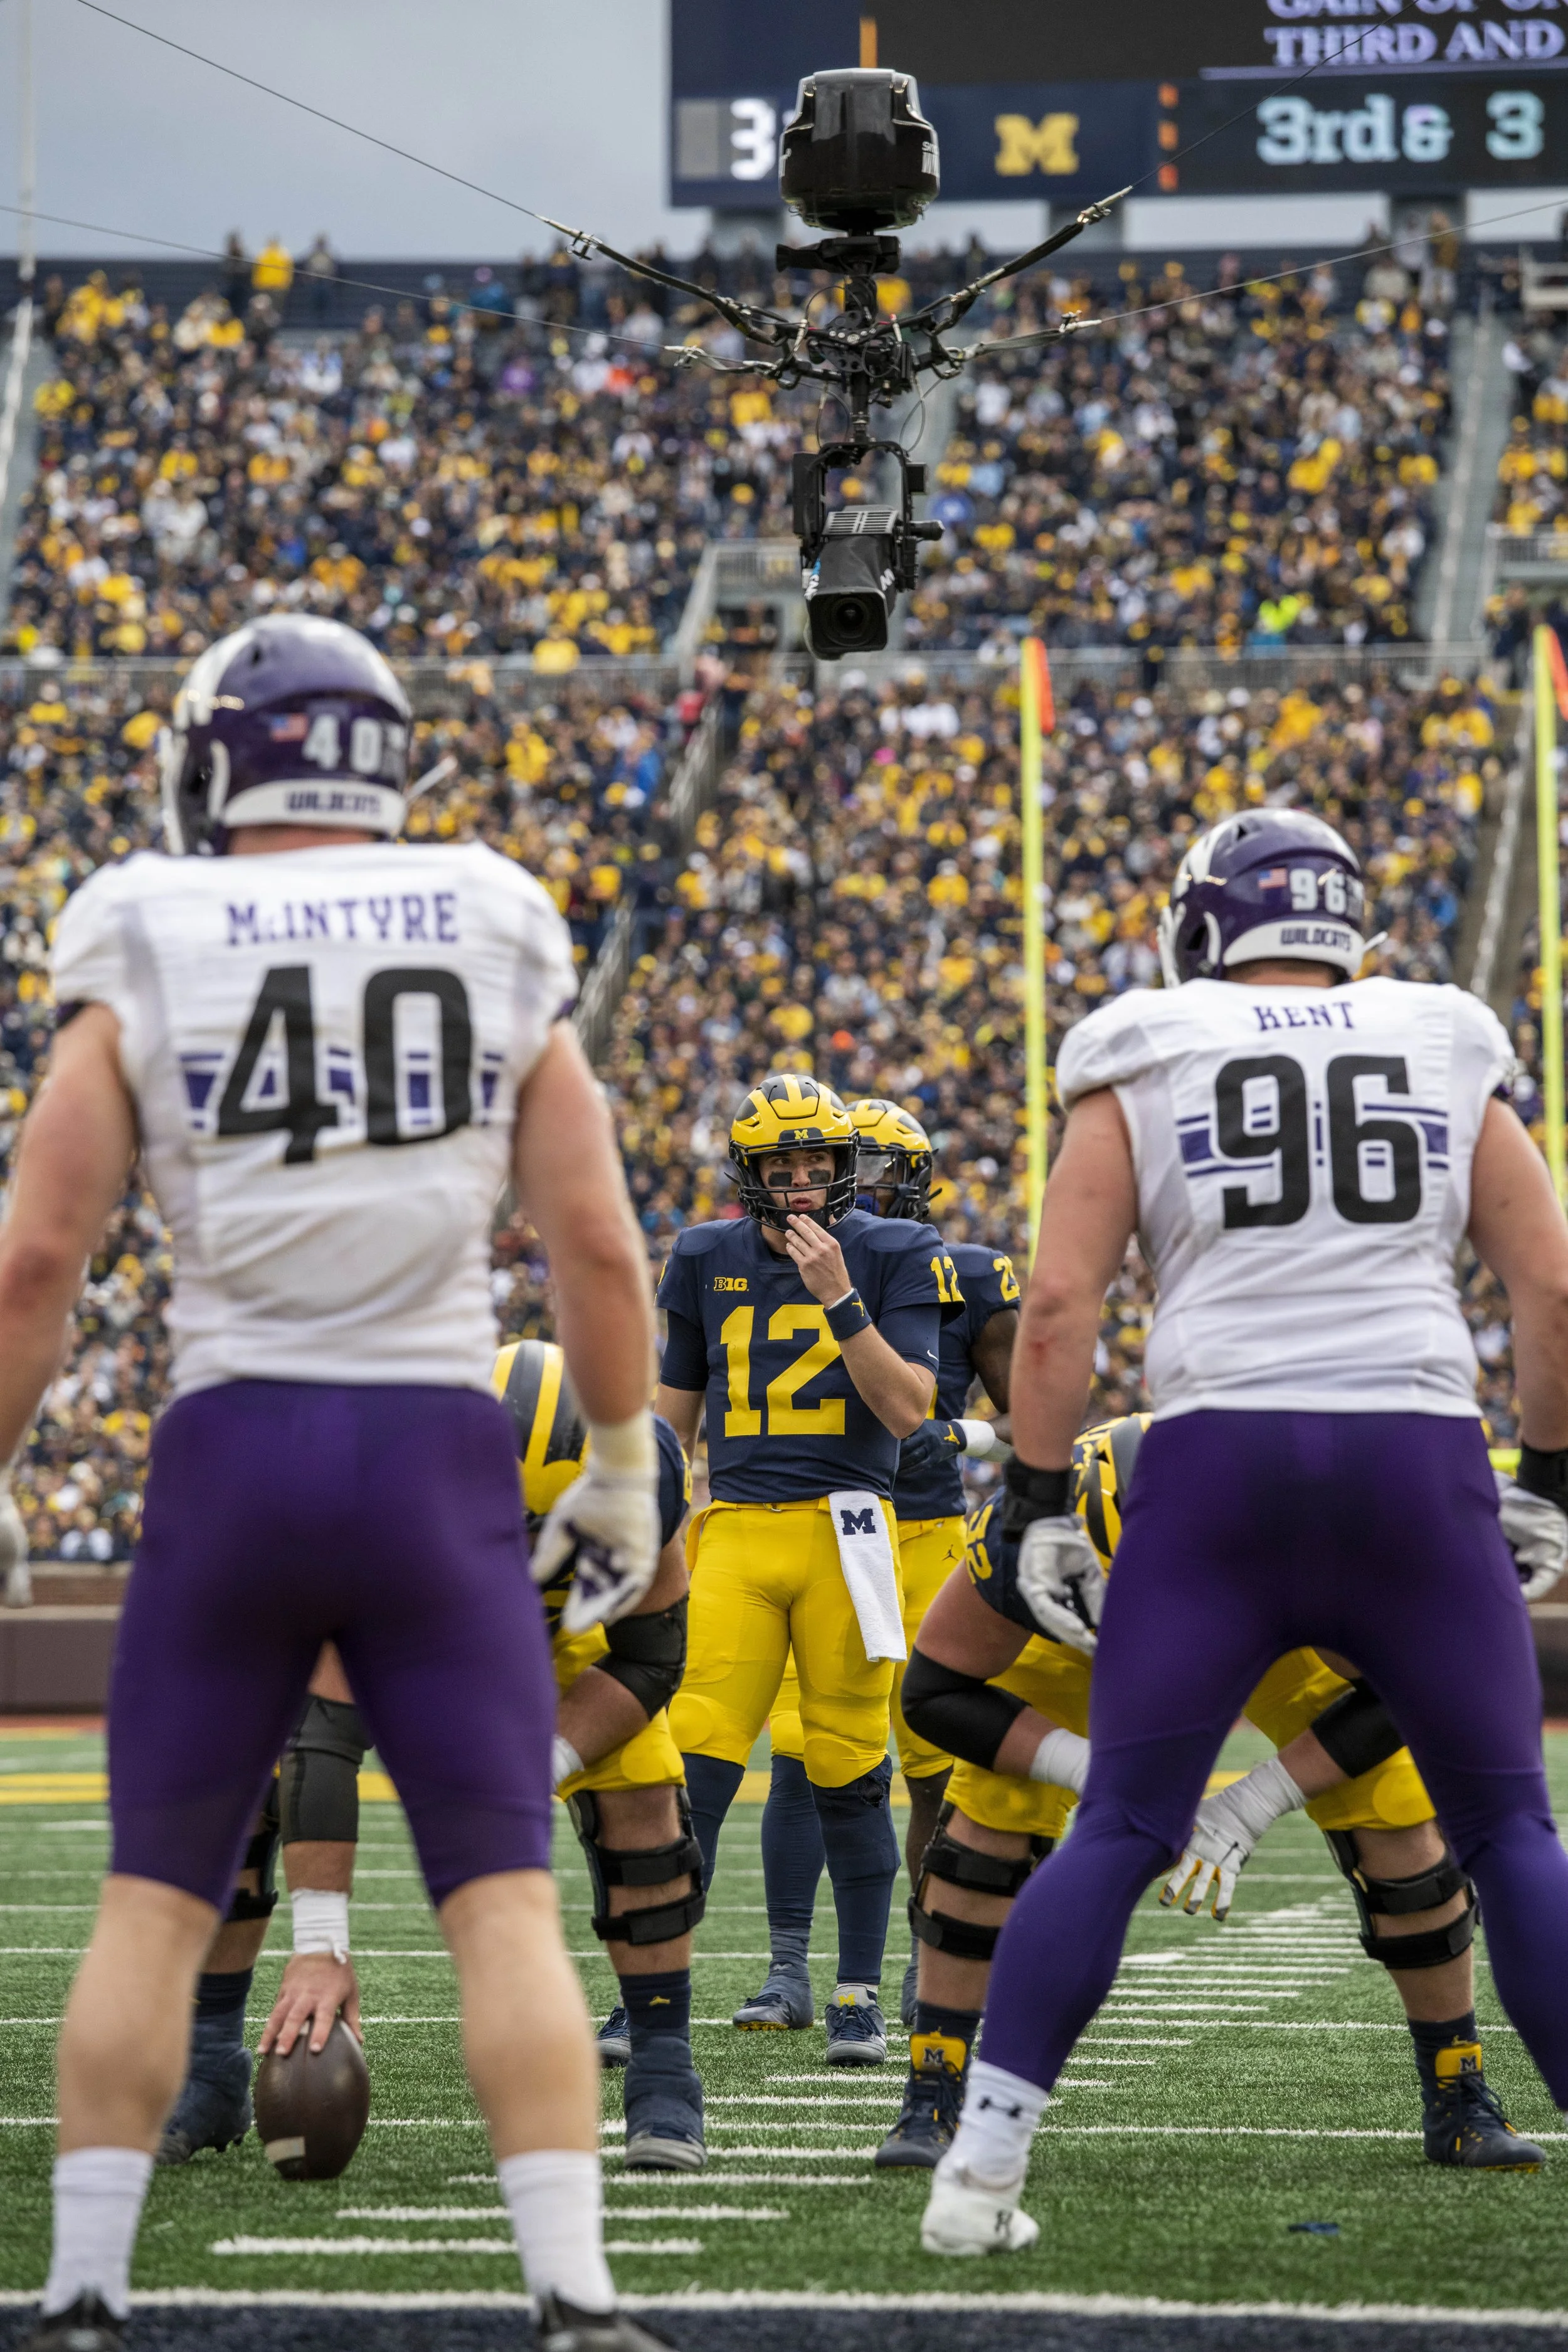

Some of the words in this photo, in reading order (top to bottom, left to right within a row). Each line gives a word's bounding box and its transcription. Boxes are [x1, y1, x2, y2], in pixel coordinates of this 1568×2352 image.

[1263, 23, 1438, 66] THIRD
[1444, 19, 1566, 61] AND
[994, 113, 1079, 177] M
[1485, 90, 1545, 161] 3
[303, 714, 381, 775] 40
[1290, 868, 1347, 915] 96
[1280, 927, 1352, 953] WILDCATS
[1253, 1002, 1357, 1032] KENT
[218, 964, 473, 1165] 40
[793, 1129, 809, 1140] M
[1215, 1054, 1422, 1231] 96
[931, 1256, 966, 1303] 12
[720, 1304, 846, 1438] 12
[840, 1508, 877, 1536] M
[837, 1993, 856, 2008] M
[923, 2047, 945, 2065] M
[1459, 2055, 1477, 2074] M
